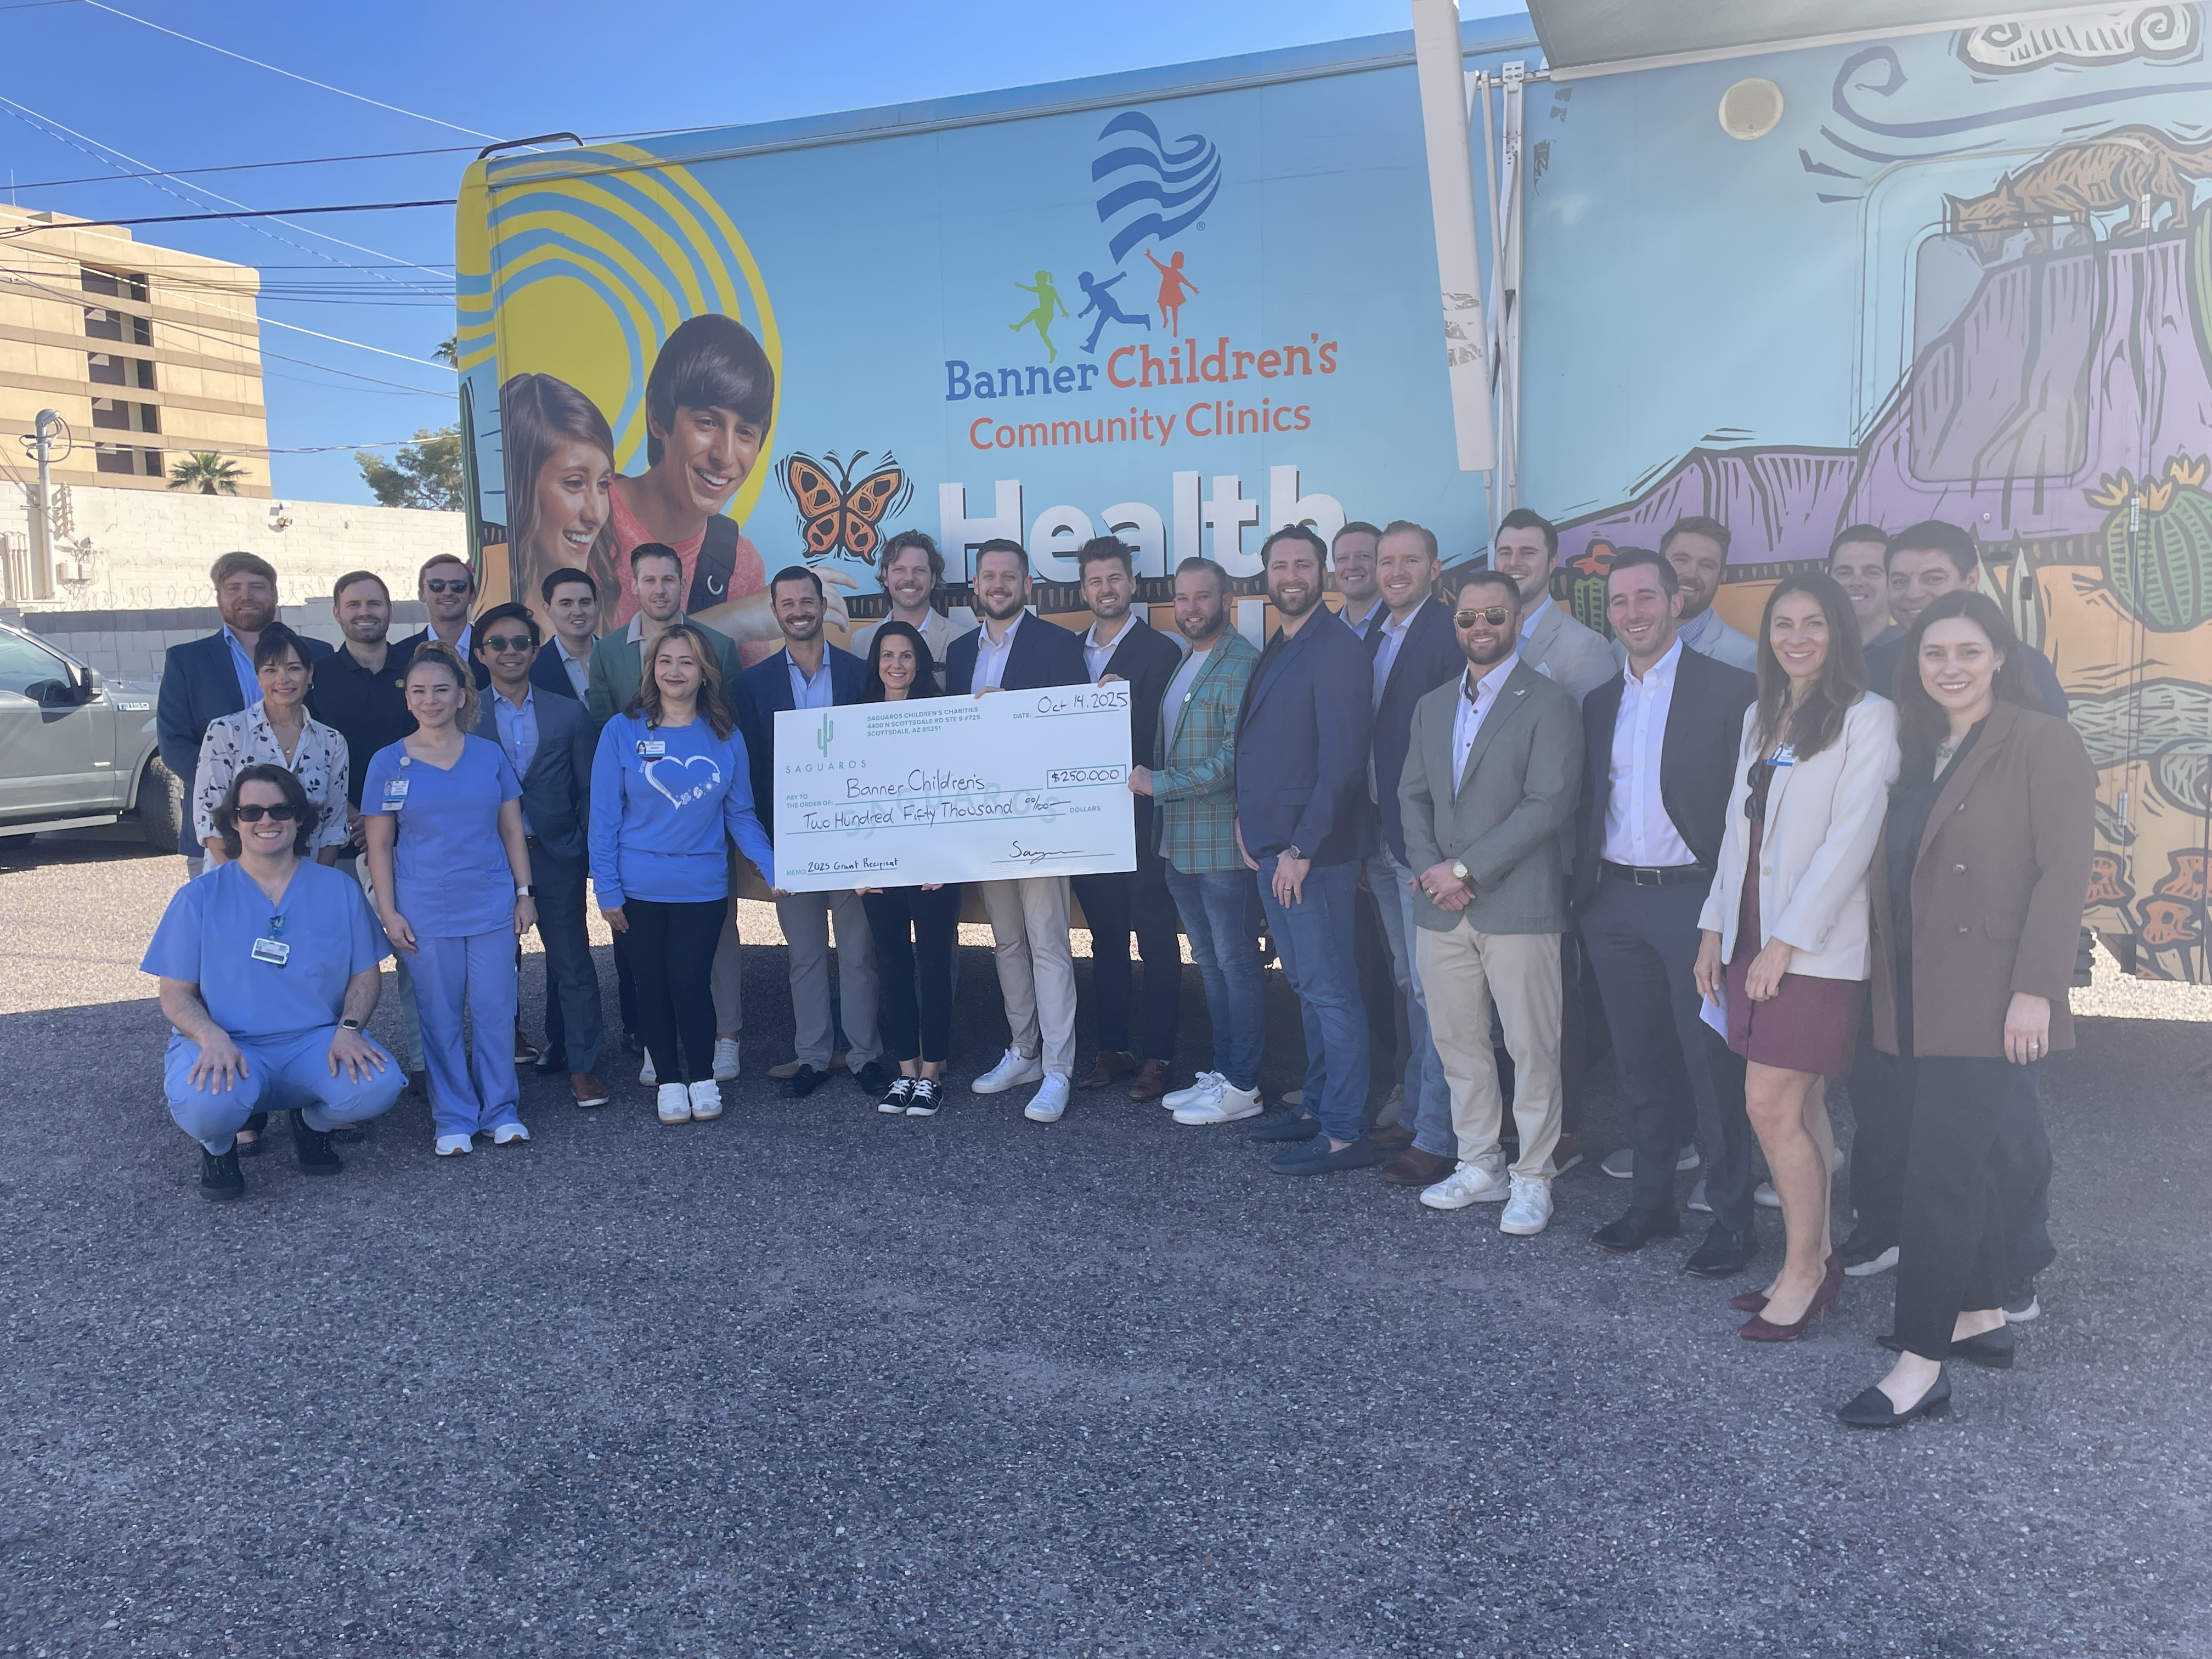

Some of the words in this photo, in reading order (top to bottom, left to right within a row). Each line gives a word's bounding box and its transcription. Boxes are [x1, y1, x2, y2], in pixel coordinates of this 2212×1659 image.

[945, 360, 1099, 401] Banner
[1107, 332, 1338, 388] Children's
[969, 407, 1177, 450] Community
[1186, 397, 1311, 437] Clinics
[939, 465, 1346, 583] Health
[1037, 696, 1066, 713] Oct
[1091, 692, 1128, 708] 2025
[867, 713, 902, 721] SAGUAROS
[904, 710, 943, 718] CHILDREN'S
[891, 719, 933, 727] SCOTTSDALE
[867, 728, 911, 737] SCOTTSDALE,
[786, 759, 866, 774] SAGUAROS
[847, 778, 904, 799] Banner
[908, 769, 985, 791] Children's
[803, 812, 831, 830] Two
[835, 807, 894, 829] Hundred
[904, 804, 935, 828] Fifty
[941, 798, 1013, 818] Thousand
[808, 861, 830, 872] 2025
[833, 860, 859, 870] Grant
[863, 857, 899, 870] Recipient
